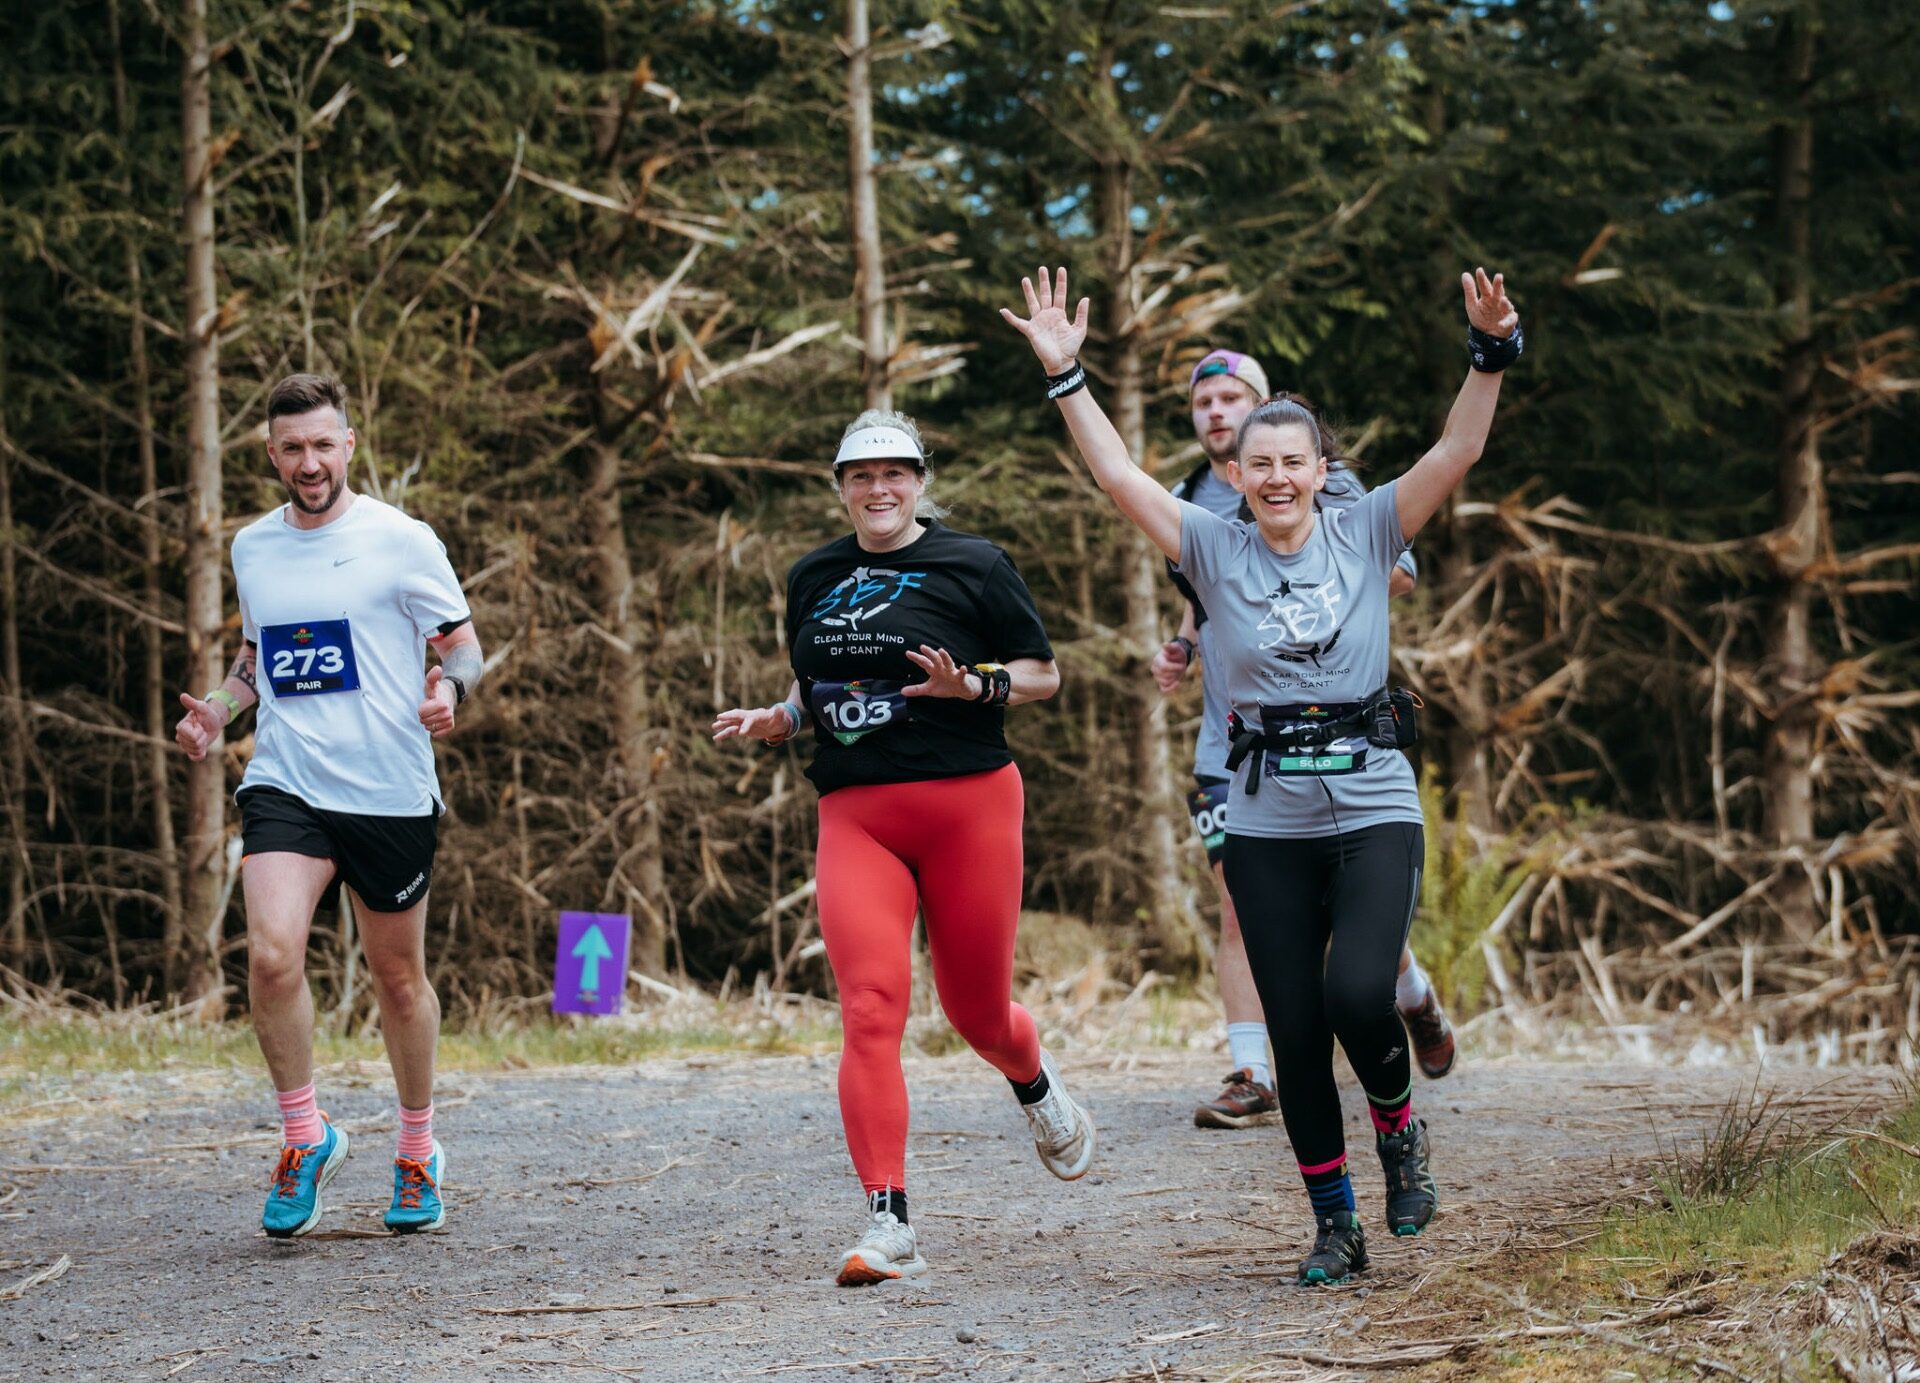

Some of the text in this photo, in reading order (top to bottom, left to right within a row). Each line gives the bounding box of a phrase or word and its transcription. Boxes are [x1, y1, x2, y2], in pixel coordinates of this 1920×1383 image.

[812, 573, 927, 619] SBF
[1256, 579, 1341, 650] SBF
[814, 633, 904, 644] CLEAR YOUR MIND
[830, 647, 843, 655] OF
[272, 645, 344, 678] 273
[1261, 667, 1350, 679] CLEAR YOUR MIND
[296, 680, 322, 691] PAIR
[1280, 681, 1293, 689] OF
[823, 700, 892, 729] 103
[1299, 759, 1332, 768] SOLO
